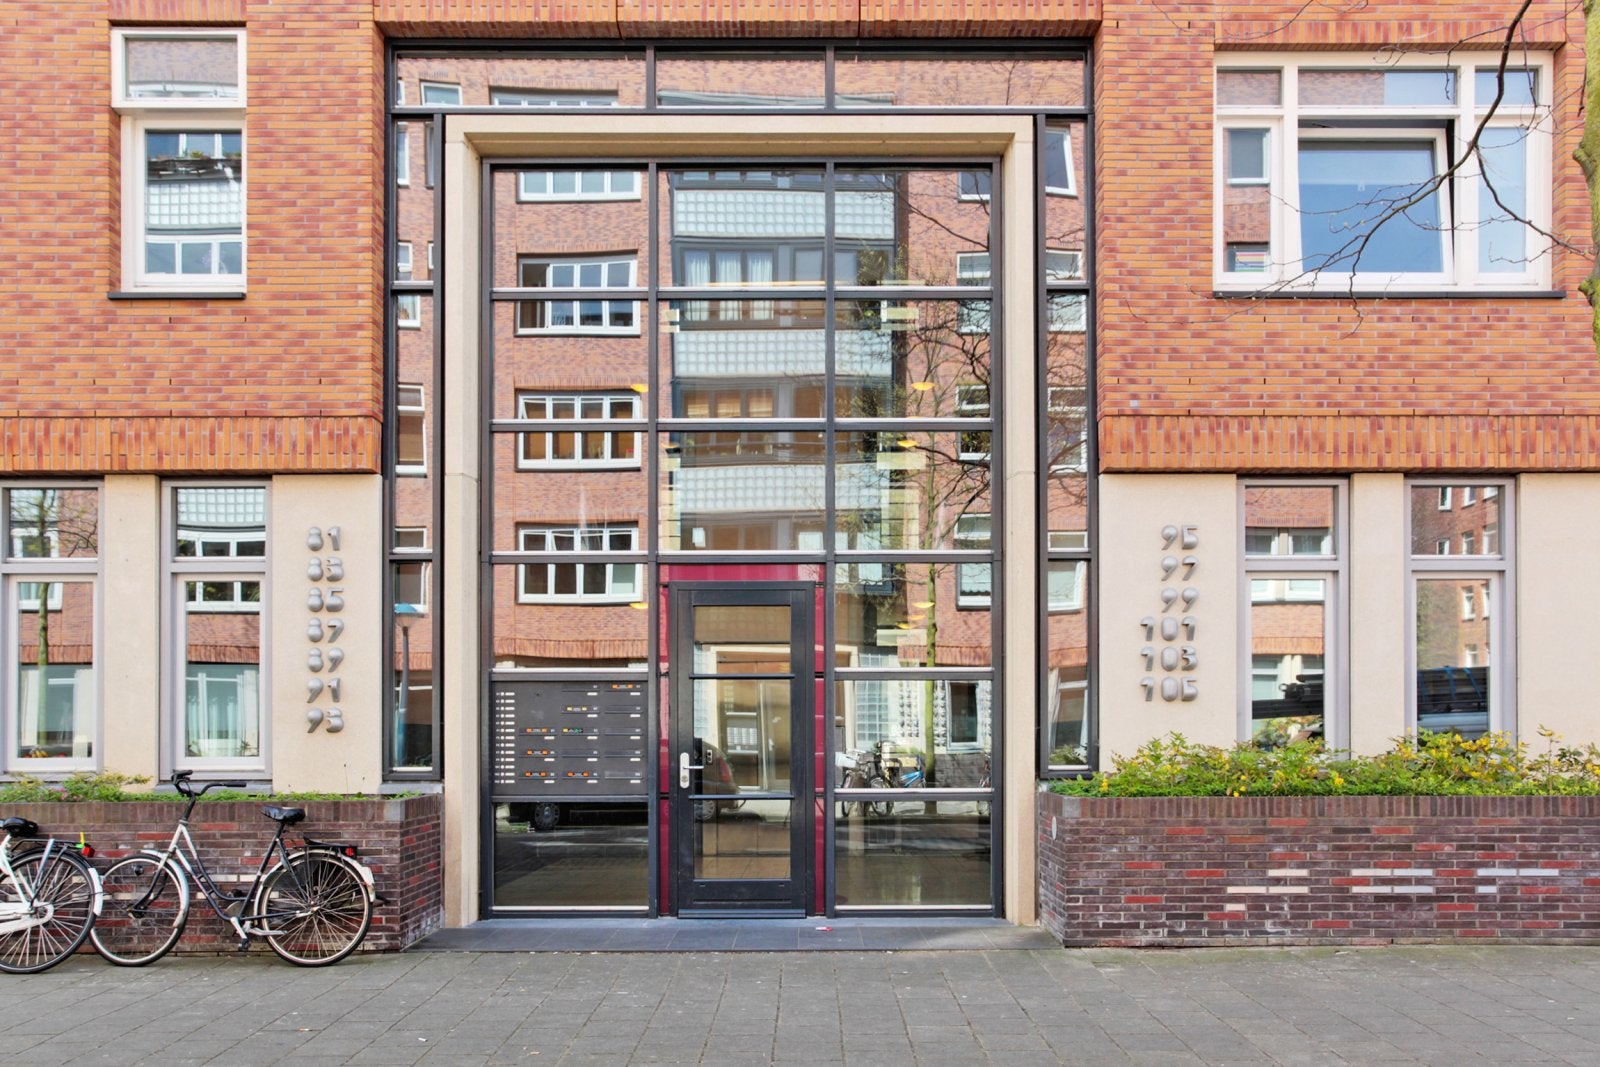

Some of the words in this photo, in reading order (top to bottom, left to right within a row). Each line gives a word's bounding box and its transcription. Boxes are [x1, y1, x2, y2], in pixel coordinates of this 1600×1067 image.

[307, 526, 342, 551] 81
[1161, 525, 1199, 551] 95
[307, 557, 345, 582] 83
[1161, 555, 1199, 581] 97
[307, 587, 345, 612] 85
[1161, 587, 1199, 613] 99
[307, 617, 345, 643] 87
[1140, 616, 1197, 642] 101
[307, 647, 345, 673] 89
[1140, 646, 1199, 672] 103
[307, 677, 342, 704] 91
[1140, 676, 1199, 702] 105
[307, 707, 345, 734] 93
